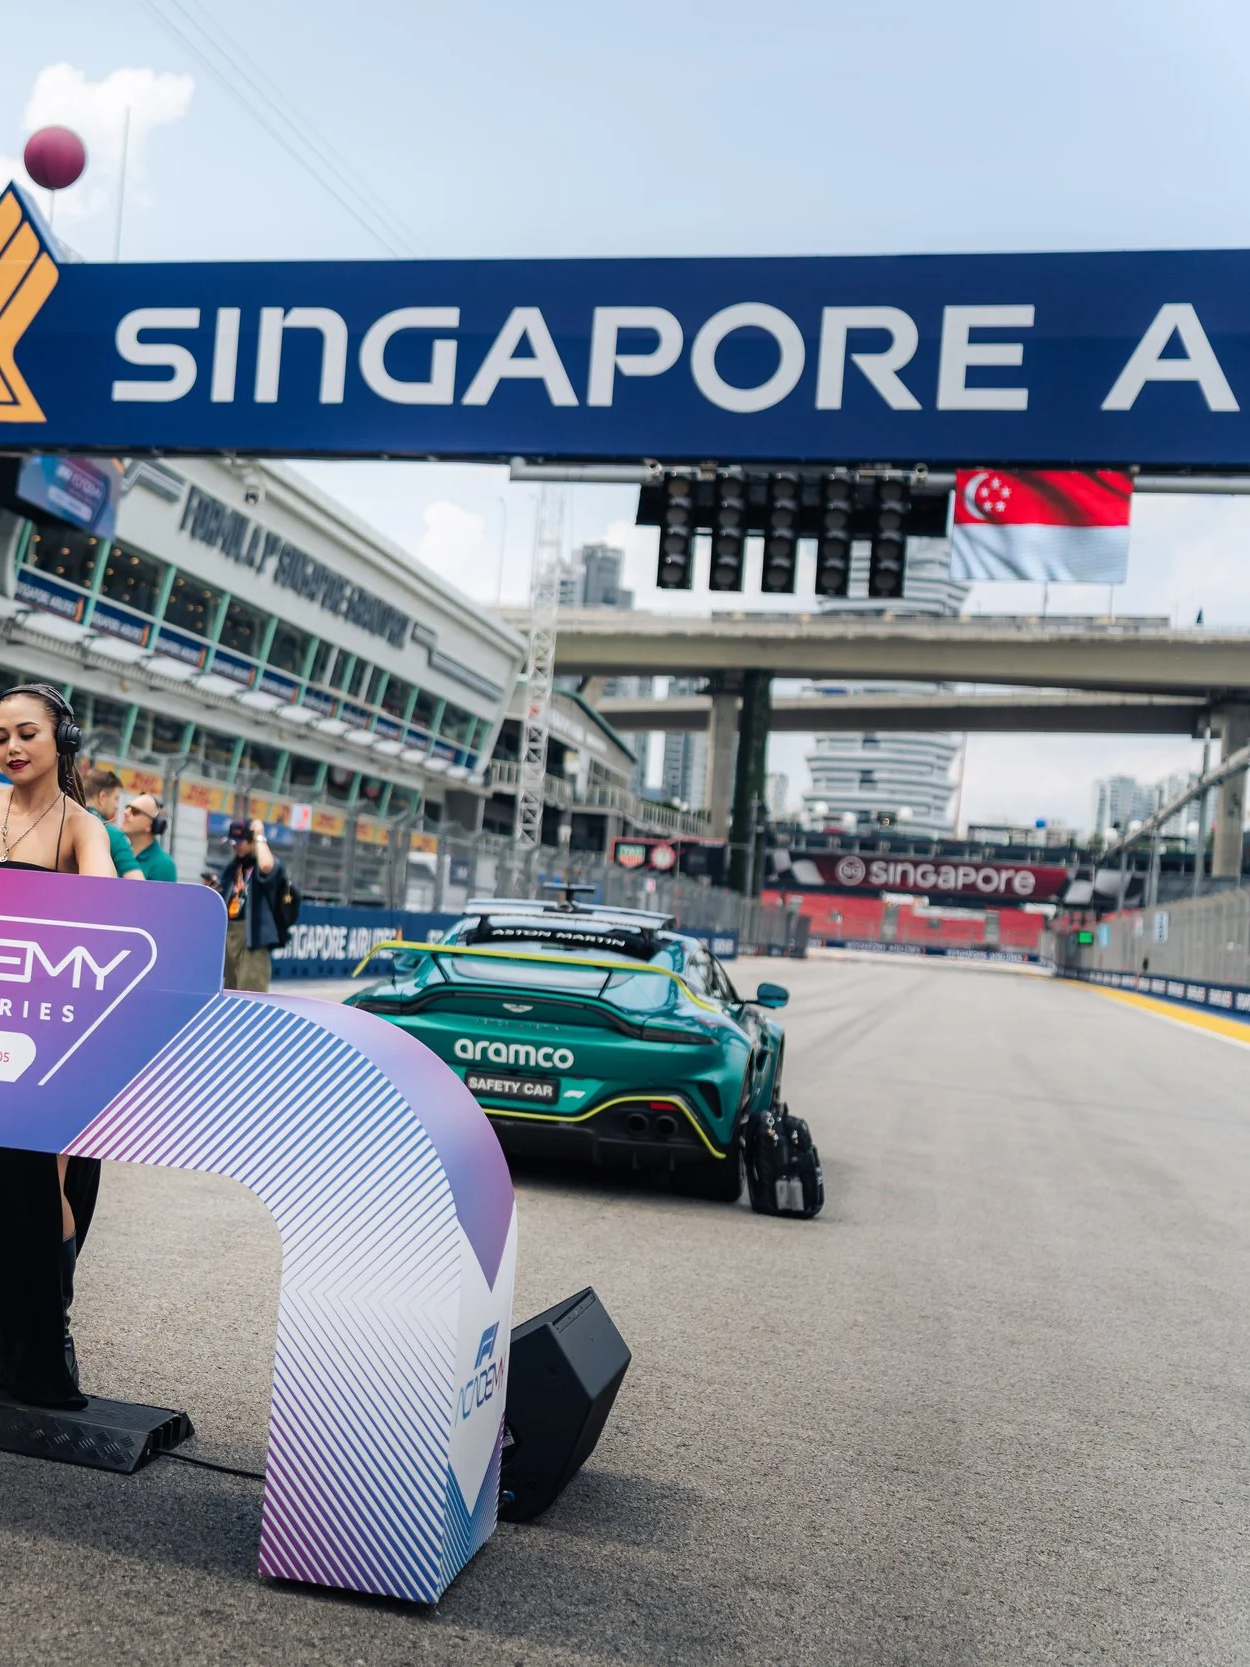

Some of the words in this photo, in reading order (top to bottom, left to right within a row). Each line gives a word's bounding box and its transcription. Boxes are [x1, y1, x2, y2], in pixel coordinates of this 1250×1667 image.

[111, 302, 1036, 413] SINGAPORE
[491, 928, 552, 938] ASTON
[555, 931, 626, 947] MARTIN
[453, 1038, 575, 1070] aramco
[468, 1076, 521, 1094] SAFETY
[523, 1083, 553, 1098] CAR
